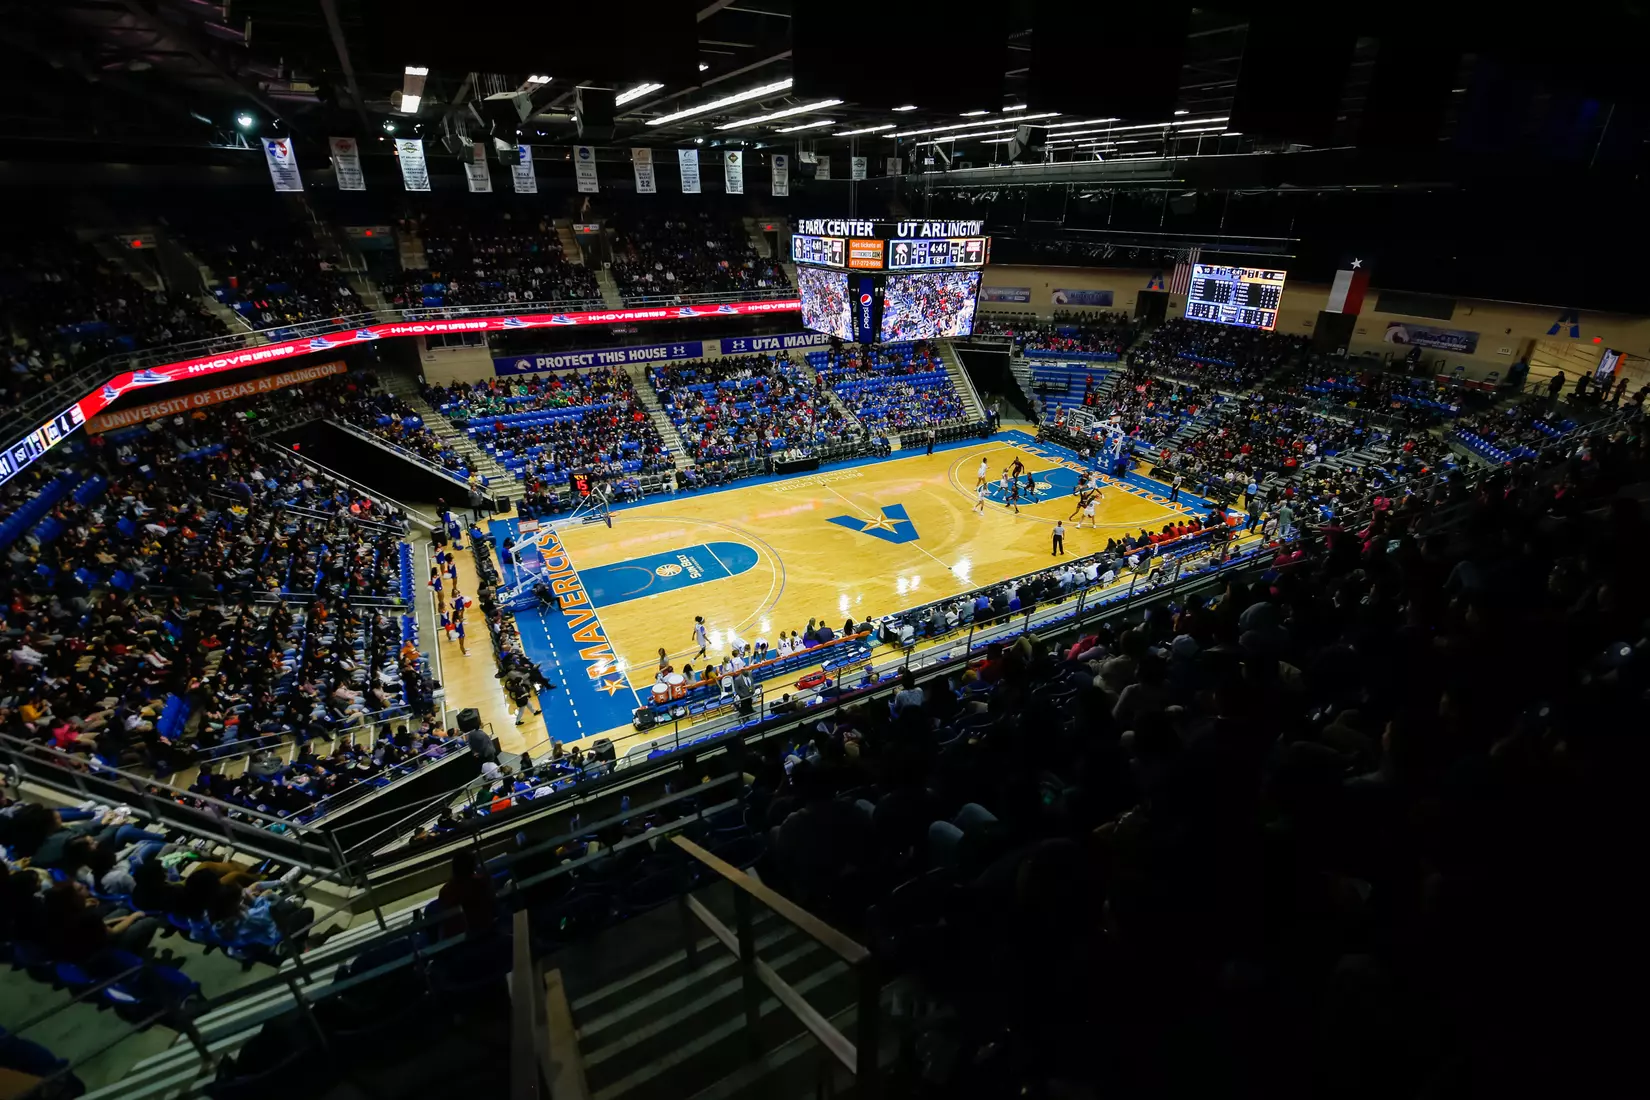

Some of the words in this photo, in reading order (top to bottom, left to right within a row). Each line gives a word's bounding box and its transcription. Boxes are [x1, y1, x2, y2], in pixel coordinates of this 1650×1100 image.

[806, 220, 826, 234] PARK
[827, 221, 874, 236] CENTER
[897, 222, 918, 237] UT
[920, 221, 980, 237] ARLINGTON
[930, 243, 947, 253] 4:41
[895, 253, 907, 265] 10
[970, 252, 976, 262] 4
[401, 324, 447, 333] HOVR
[752, 338, 780, 350] UTA
[200, 354, 252, 370] HOVR
[536, 354, 594, 369] PROTECT
[598, 350, 626, 363] THIS
[629, 348, 667, 360] HOUSE
[103, 398, 188, 428] UNIVERSITY
[194, 392, 211, 405] OF
[215, 383, 255, 400] TEXAS
[259, 379, 272, 390] AT
[276, 364, 336, 386] ARLINGTON
[1016, 444, 1048, 456] UT
[577, 480, 588, 490] 15
[677, 554, 692, 567] BELT
[538, 533, 618, 680] MAVERICKS
